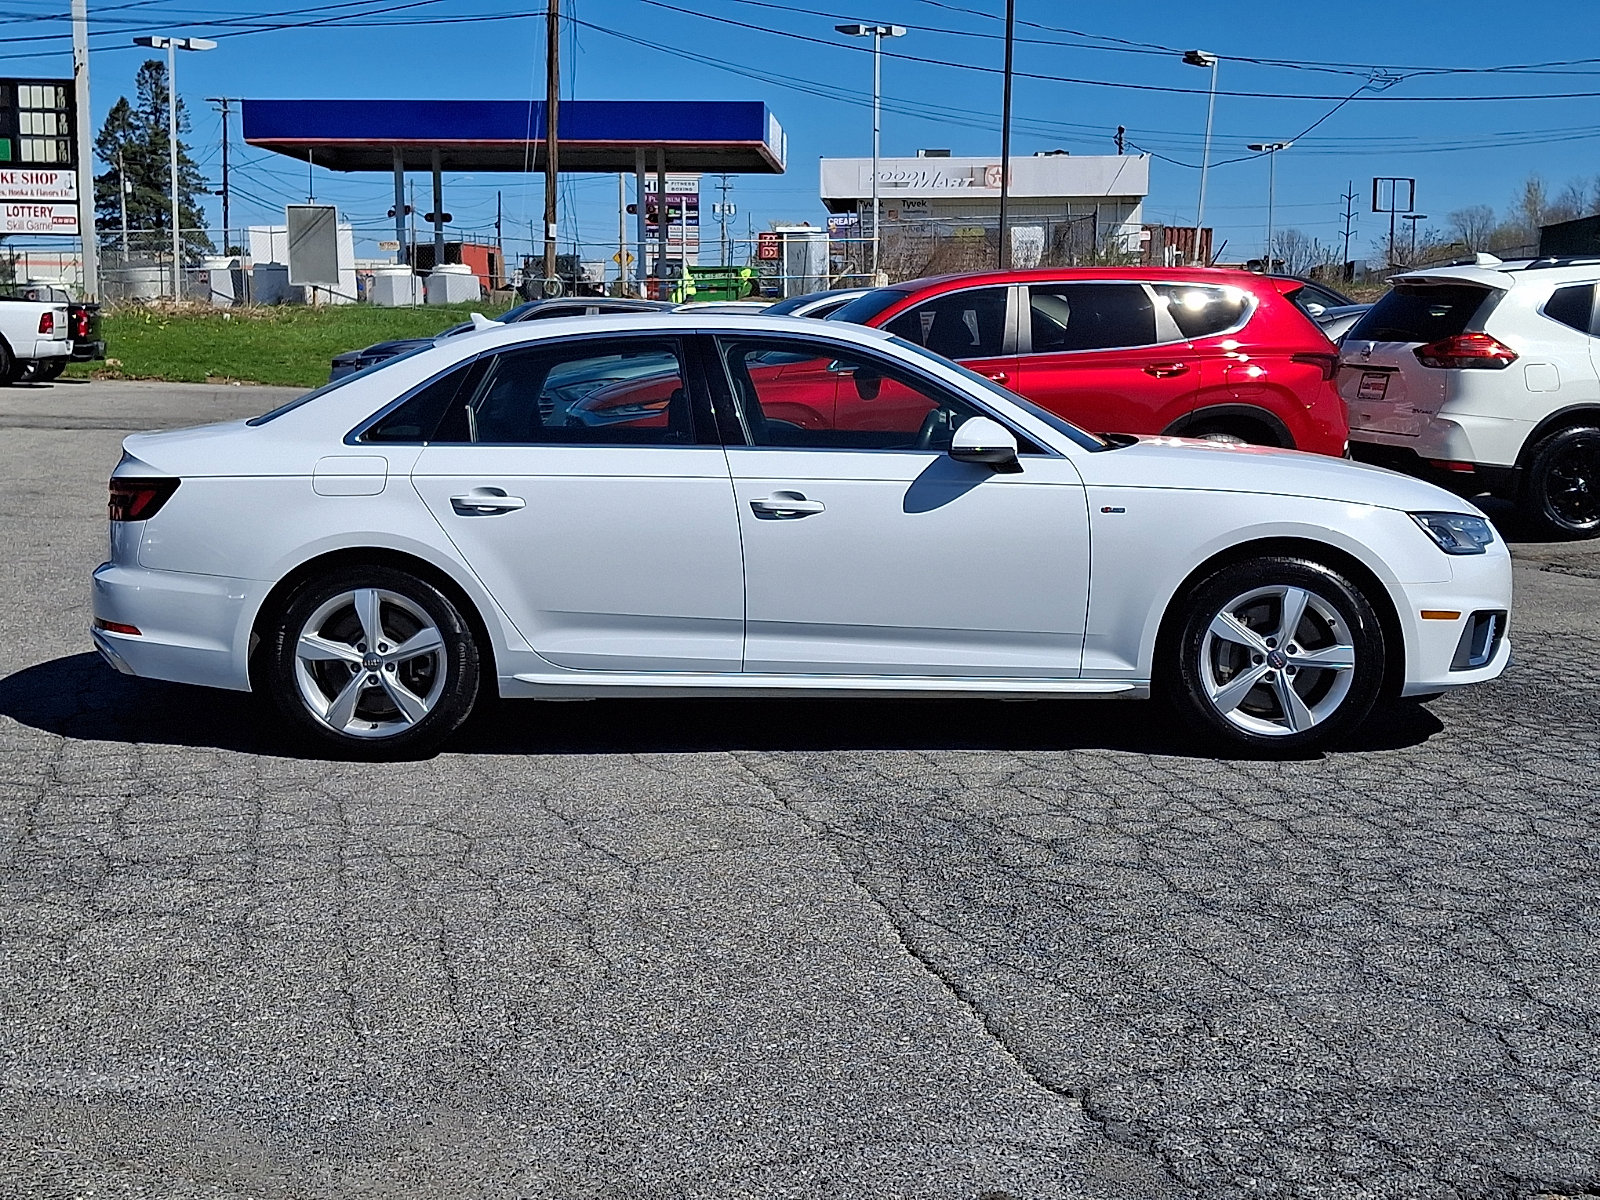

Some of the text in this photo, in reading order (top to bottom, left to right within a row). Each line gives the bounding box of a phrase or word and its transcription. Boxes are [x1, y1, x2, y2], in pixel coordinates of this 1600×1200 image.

[21, 172, 58, 185] SHOP
[860, 199, 928, 209] Tyvk Tyvek
[6, 205, 54, 218] LOTTERY
[6, 220, 53, 231] Skill Game
